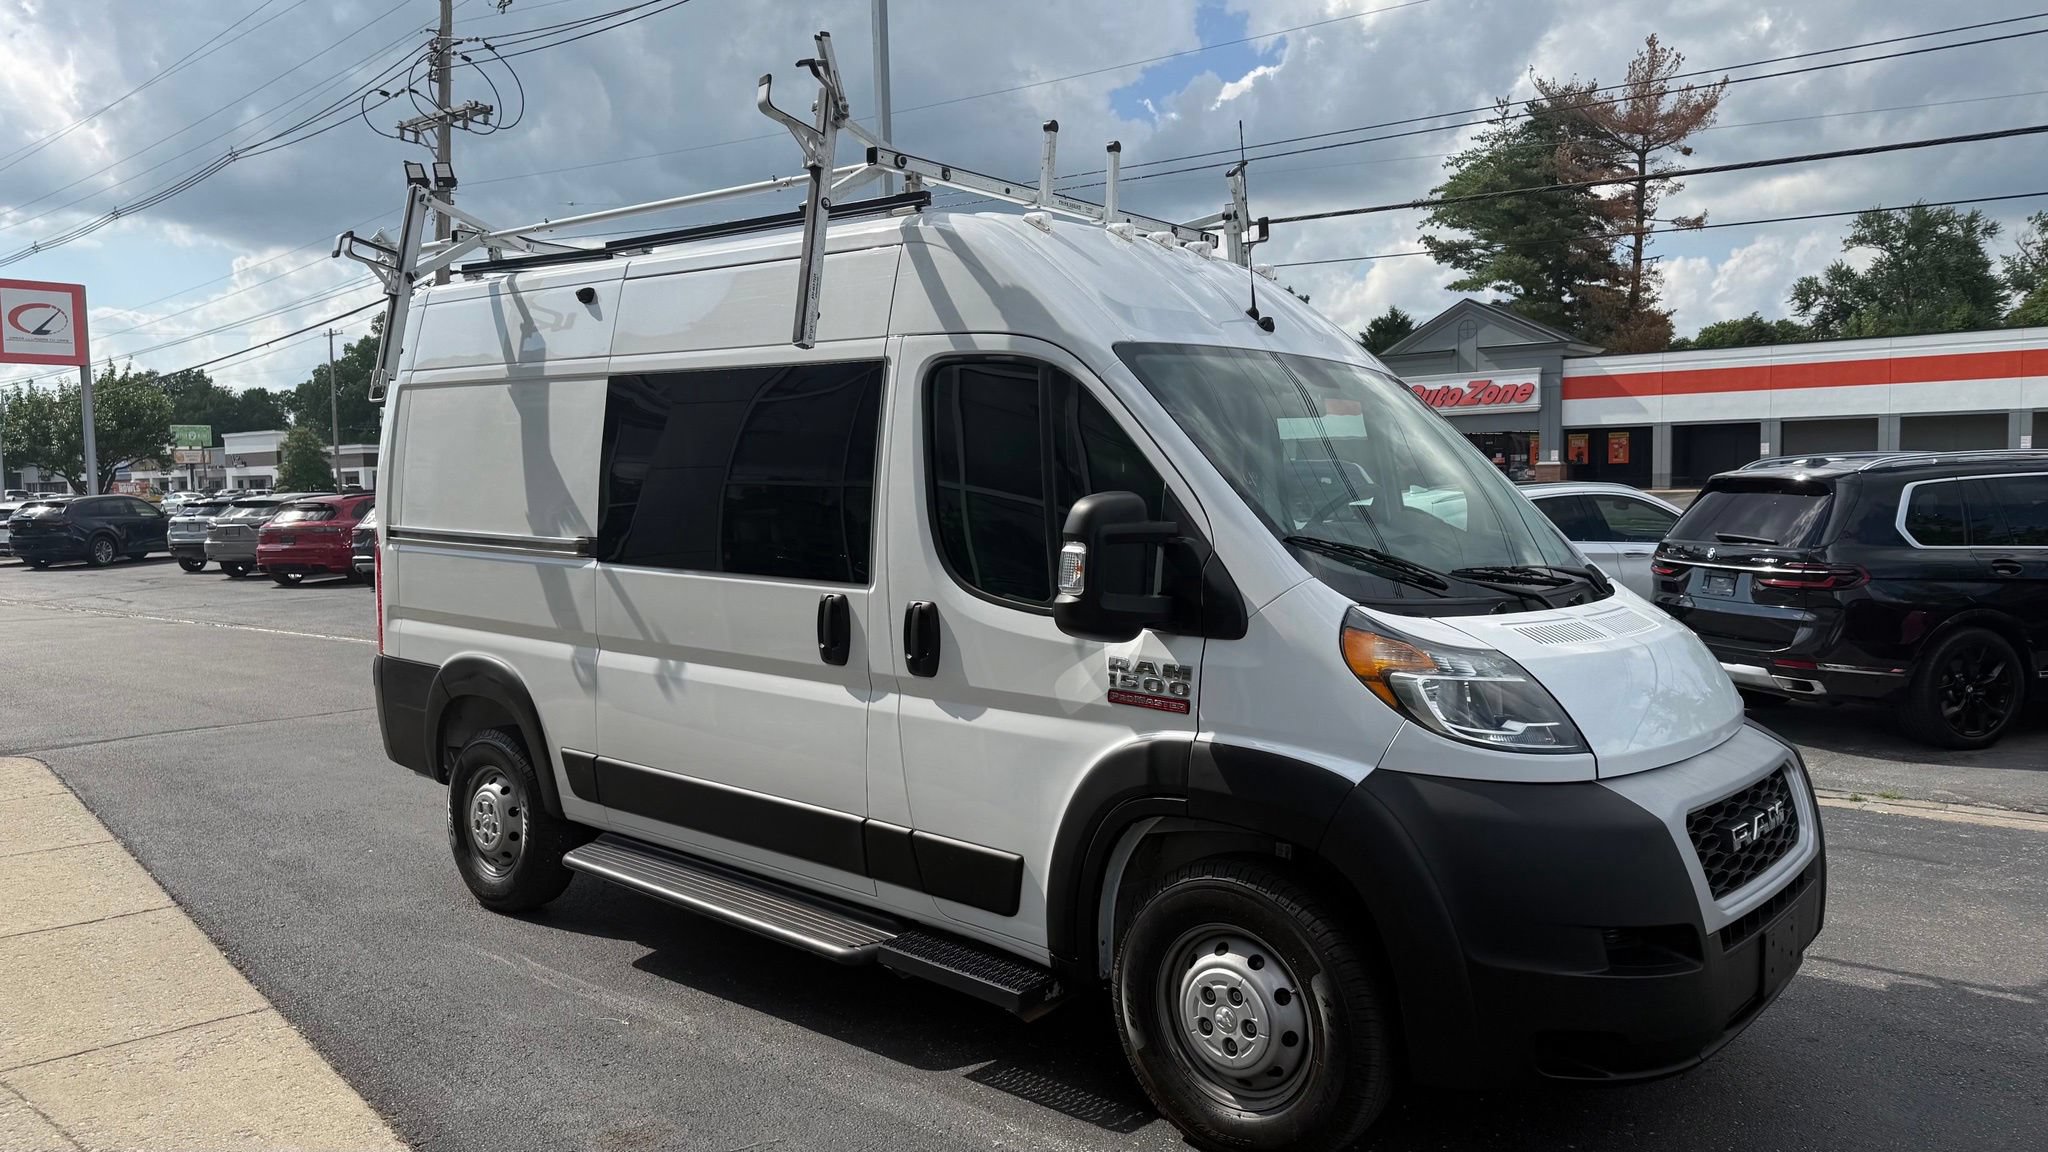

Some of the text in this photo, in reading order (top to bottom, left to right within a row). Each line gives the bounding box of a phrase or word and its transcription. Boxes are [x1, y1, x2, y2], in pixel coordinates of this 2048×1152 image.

[1108, 656, 1194, 682] RAM
[1108, 672, 1192, 698] 1500
[1731, 801, 1785, 852] RAM
